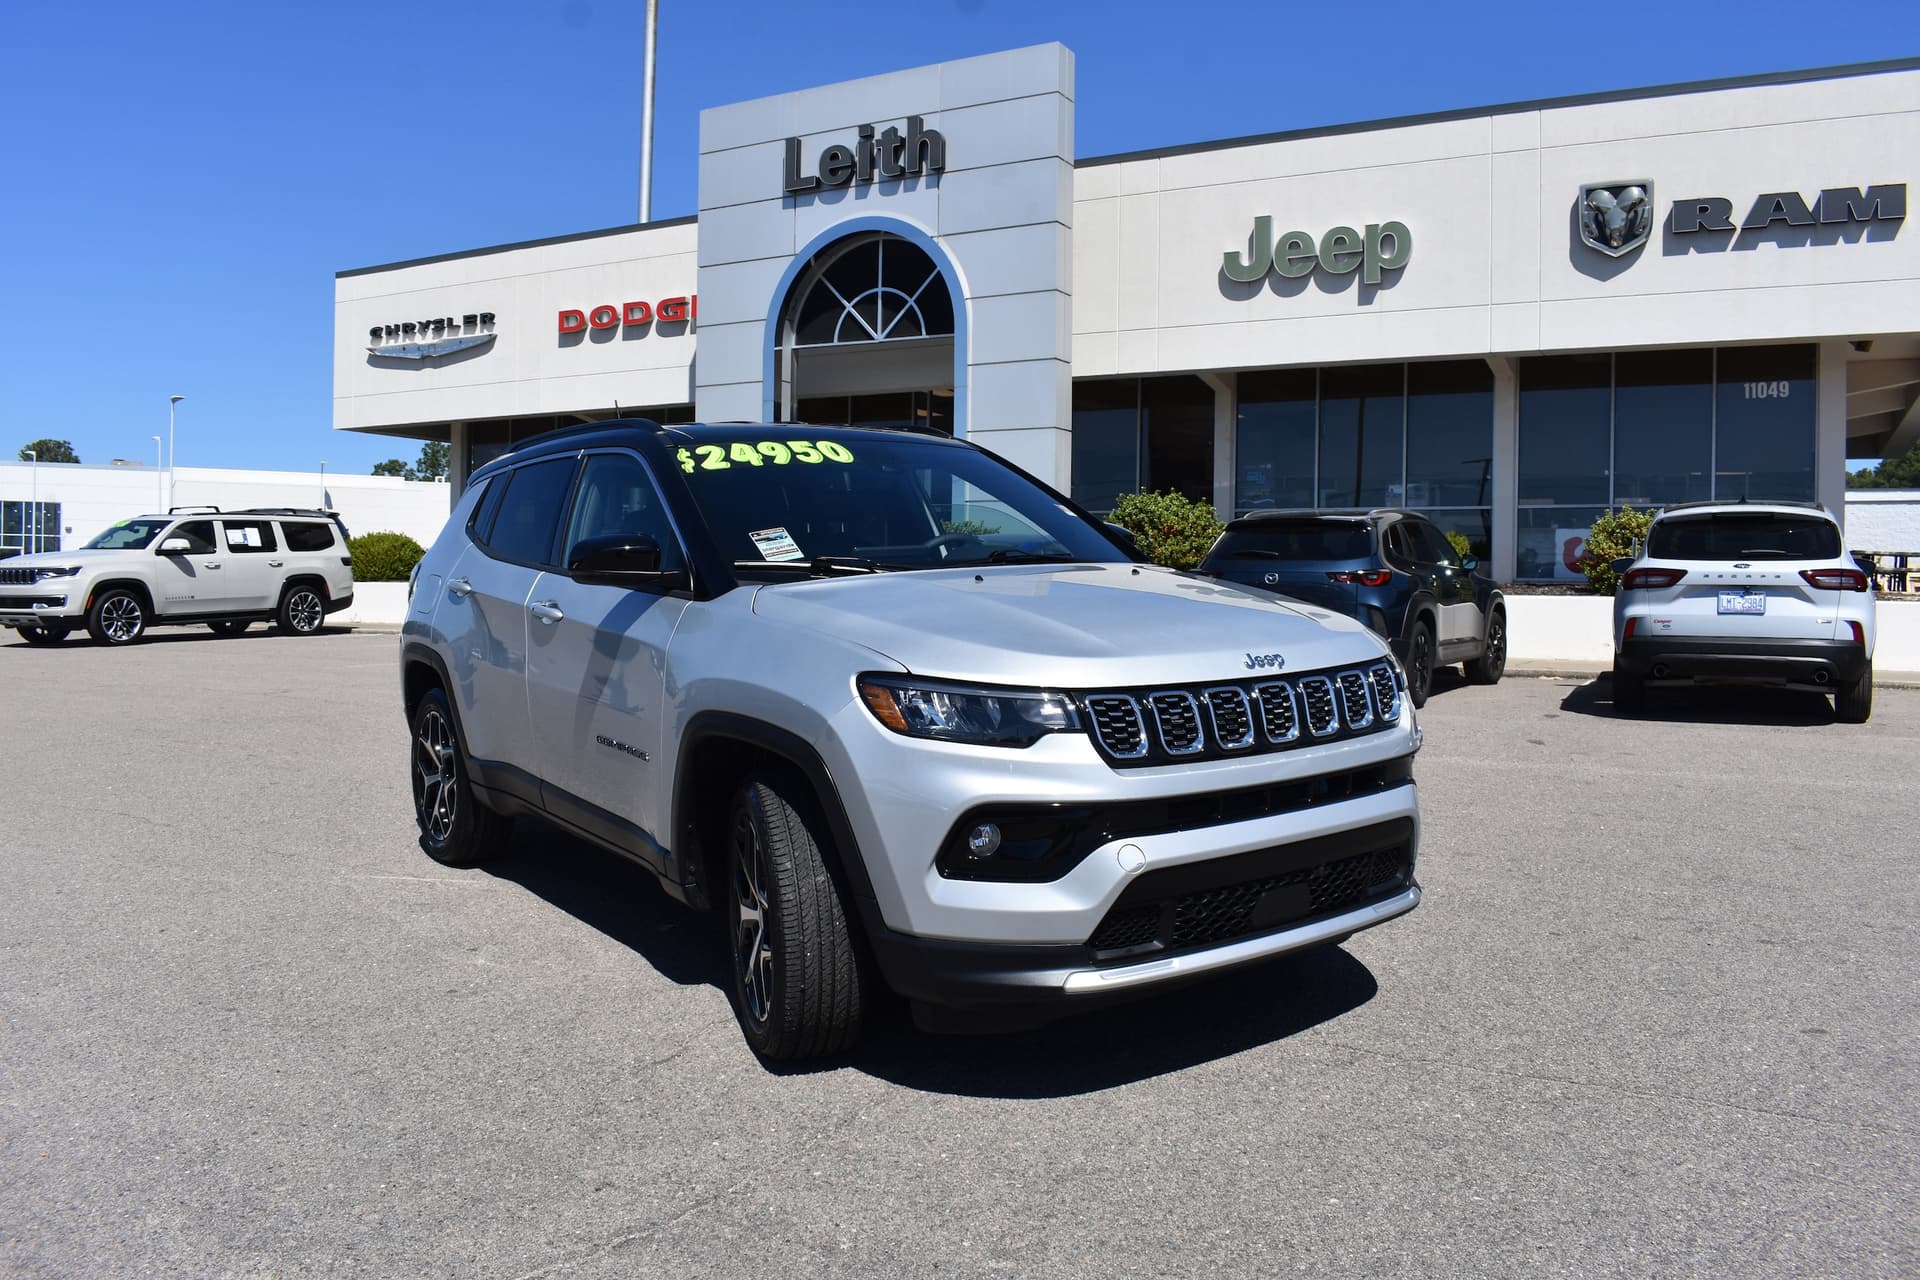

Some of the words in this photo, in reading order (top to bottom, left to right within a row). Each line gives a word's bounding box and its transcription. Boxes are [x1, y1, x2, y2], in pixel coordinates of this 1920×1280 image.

[783, 114, 946, 192] Leith
[1672, 183, 1907, 233] RAM
[1223, 215, 1412, 284] Jeep
[369, 312, 496, 338] CHRYSLER
[558, 294, 697, 334] DODG
[1743, 380, 1790, 399] 11049
[676, 440, 855, 473] $24950
[1243, 653, 1285, 670] Jeep
